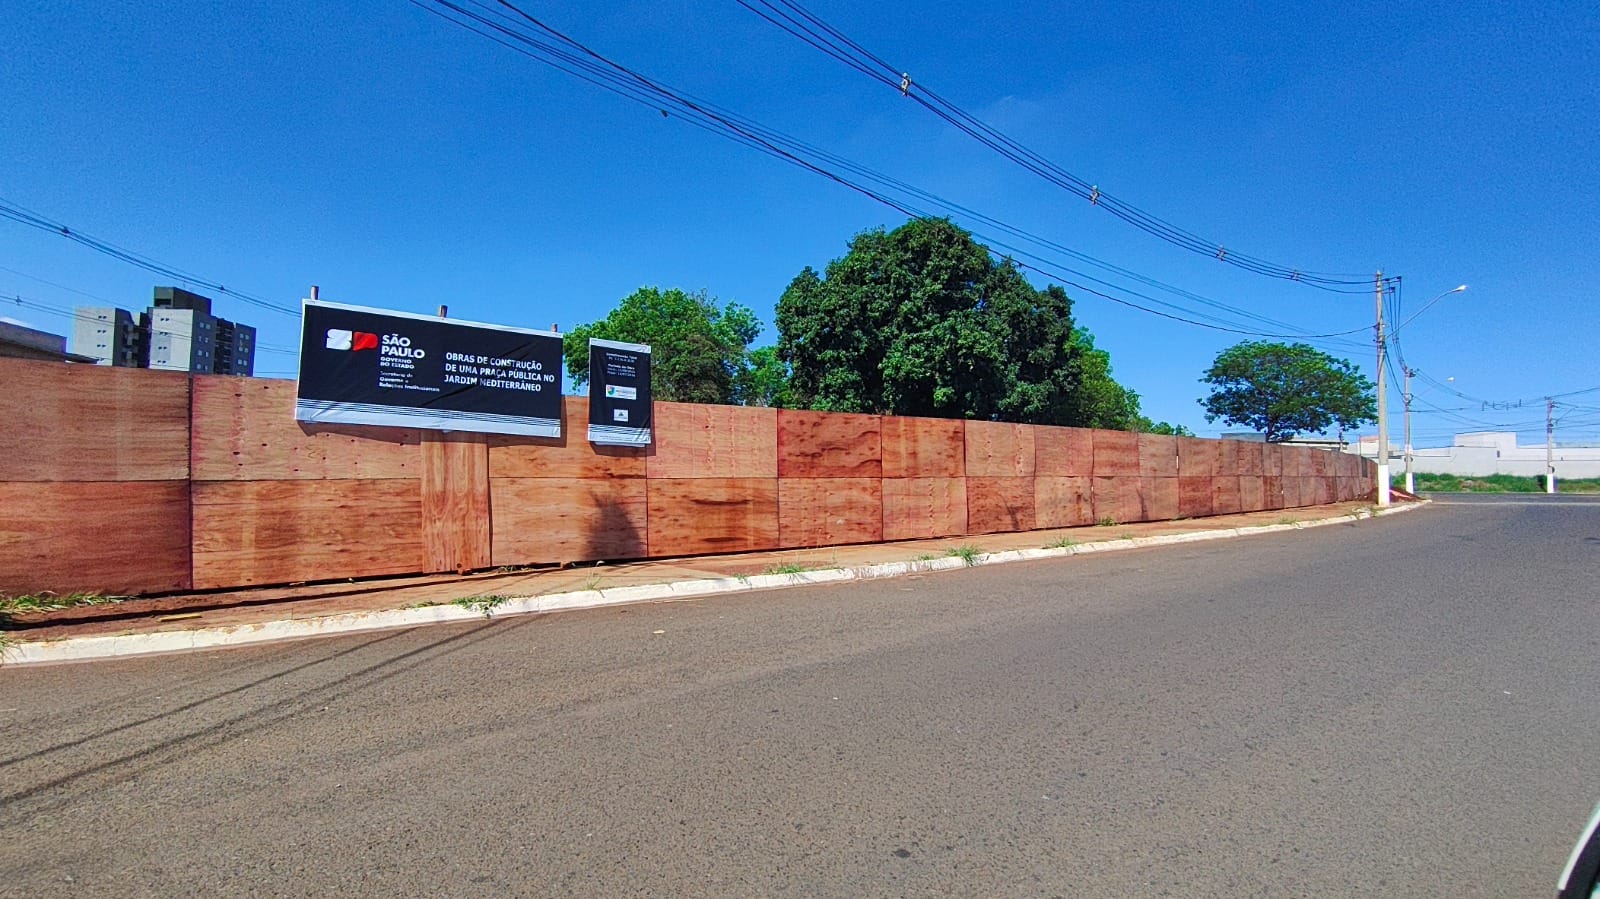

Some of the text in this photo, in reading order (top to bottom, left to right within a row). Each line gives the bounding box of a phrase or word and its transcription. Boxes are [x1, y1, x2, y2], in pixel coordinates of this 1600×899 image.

[382, 334, 410, 346] SÃO
[382, 345, 425, 358] PAULO
[446, 352, 542, 370] OBRAS DE CONSTRUÇÃO
[446, 364, 457, 372] DE
[459, 365, 477, 374] UMA
[480, 368, 506, 378] PRAÇA
[508, 369, 542, 381] PÚBLICA
[444, 374, 541, 392] JARDIM MEDITERRÂNEO
